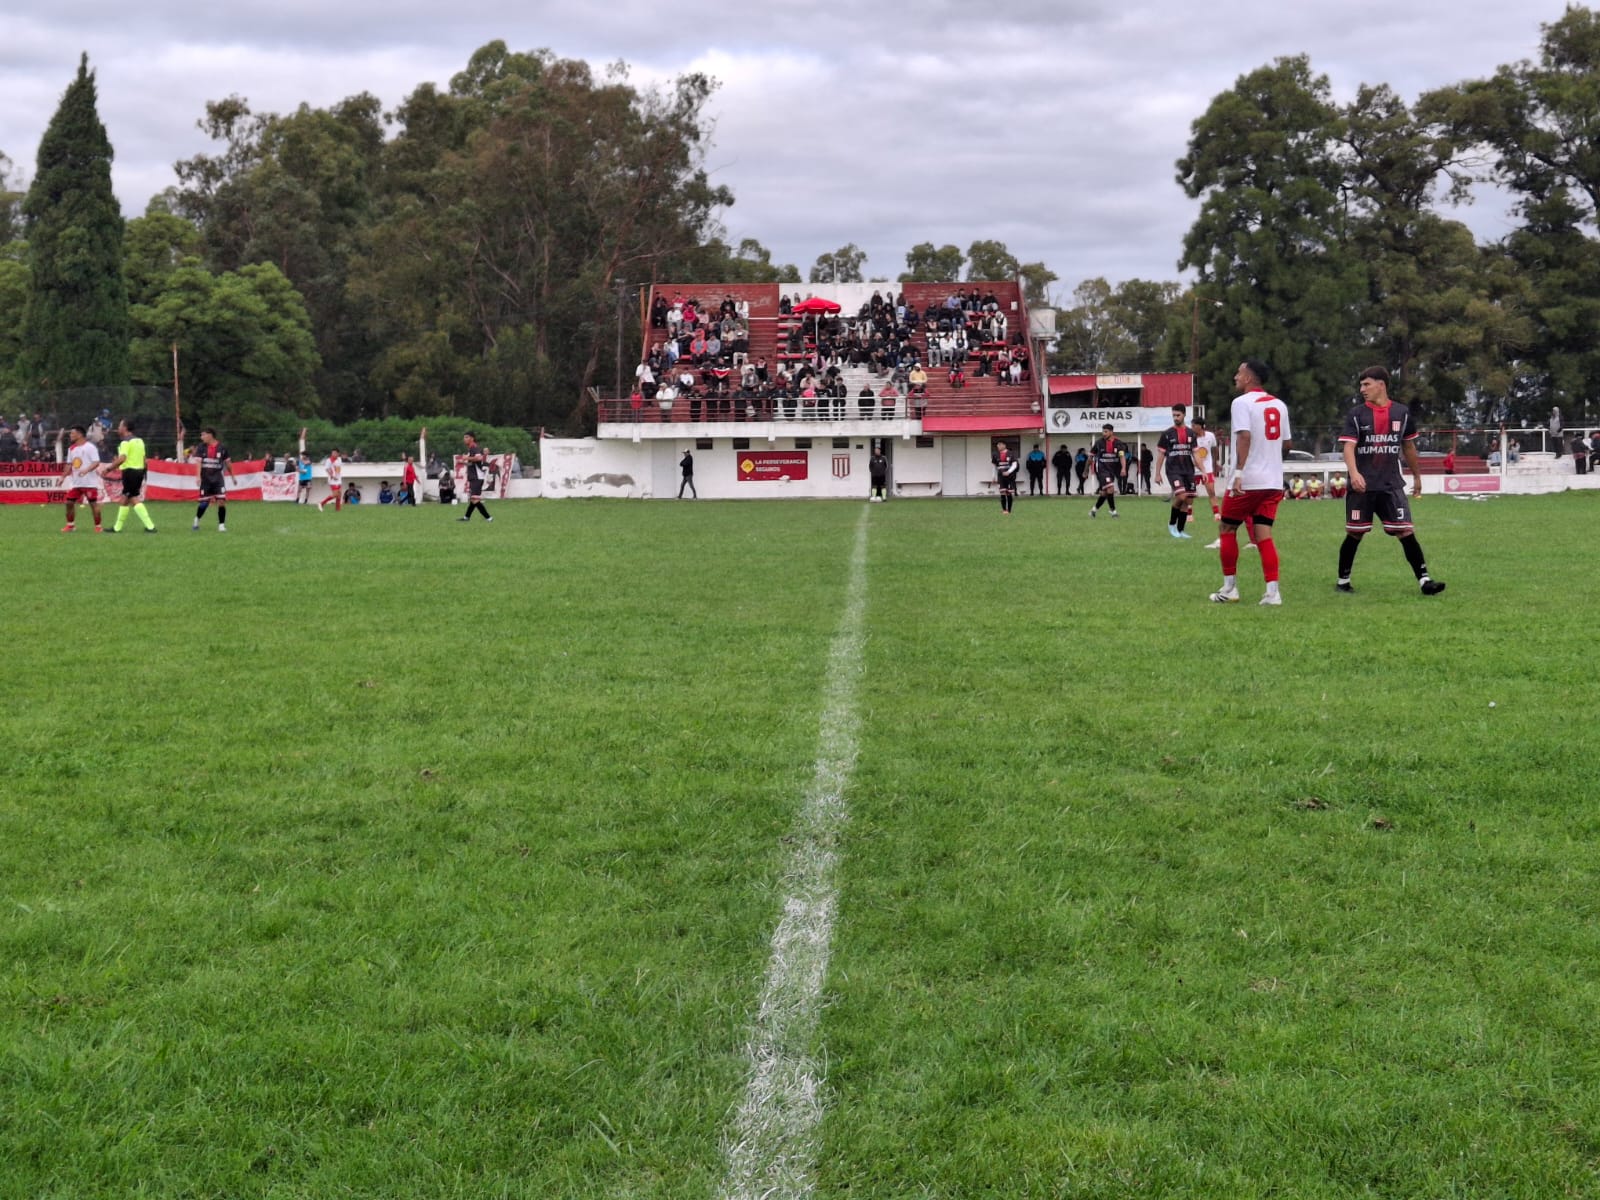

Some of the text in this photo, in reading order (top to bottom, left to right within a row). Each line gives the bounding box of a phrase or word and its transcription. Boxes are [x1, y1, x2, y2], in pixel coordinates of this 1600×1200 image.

[1080, 411, 1133, 421] ARENAS
[1264, 407, 1281, 440] 8
[1365, 434, 1399, 443] ARENAS
[14, 479, 53, 489] VOLVER
[1396, 507, 1405, 519] 3
